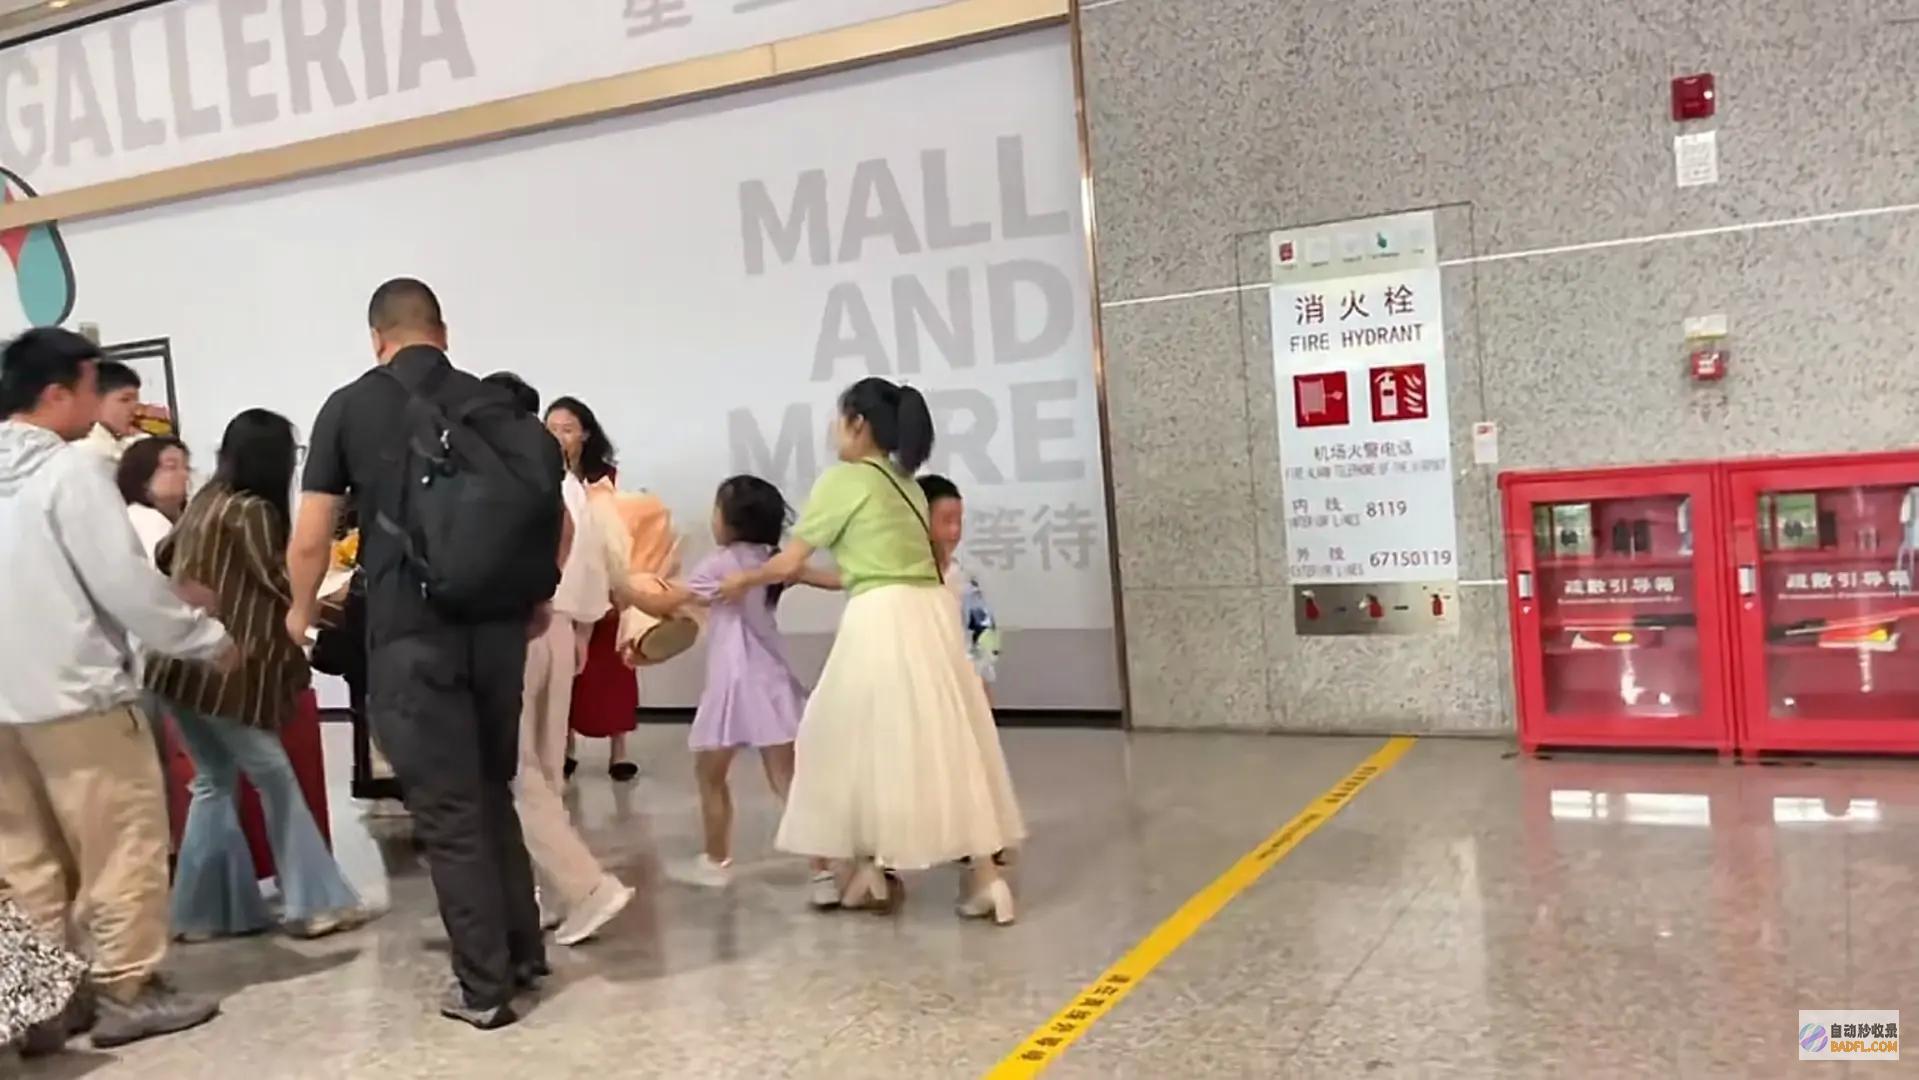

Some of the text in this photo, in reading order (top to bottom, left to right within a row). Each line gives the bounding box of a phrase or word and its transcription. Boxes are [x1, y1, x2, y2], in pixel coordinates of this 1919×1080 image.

[0, 0, 476, 175] GALLERIA
[738, 134, 1071, 275] MALL
[810, 258, 1075, 381] AND
[1294, 284, 1415, 325] 消火栓
[1290, 323, 1423, 352] FIRE HYDRANT
[727, 379, 1086, 497] MRE
[1314, 440, 1414, 461] 机场火警电话
[1366, 500, 1407, 517] 8119
[965, 502, 1098, 571] 等待
[1370, 550, 1452, 567] 67150119
